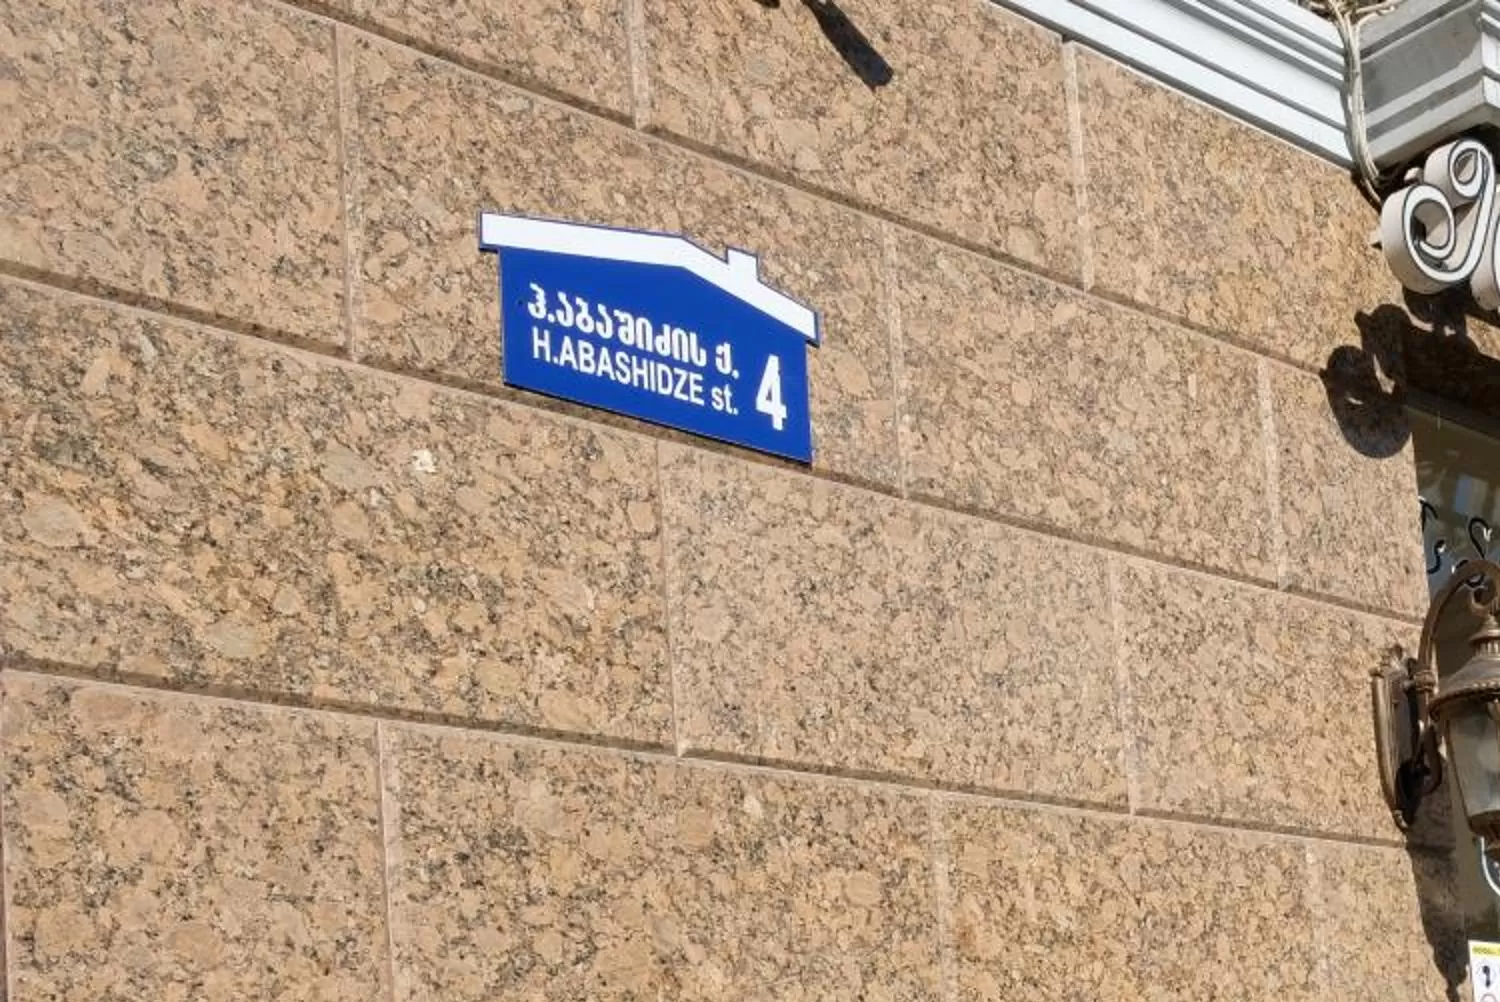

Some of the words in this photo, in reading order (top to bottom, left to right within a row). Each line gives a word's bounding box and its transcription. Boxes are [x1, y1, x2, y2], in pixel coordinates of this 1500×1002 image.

[532, 326, 705, 406] H.ABASHIDZE
[711, 384, 739, 416] st.
[756, 355, 787, 430] 4
